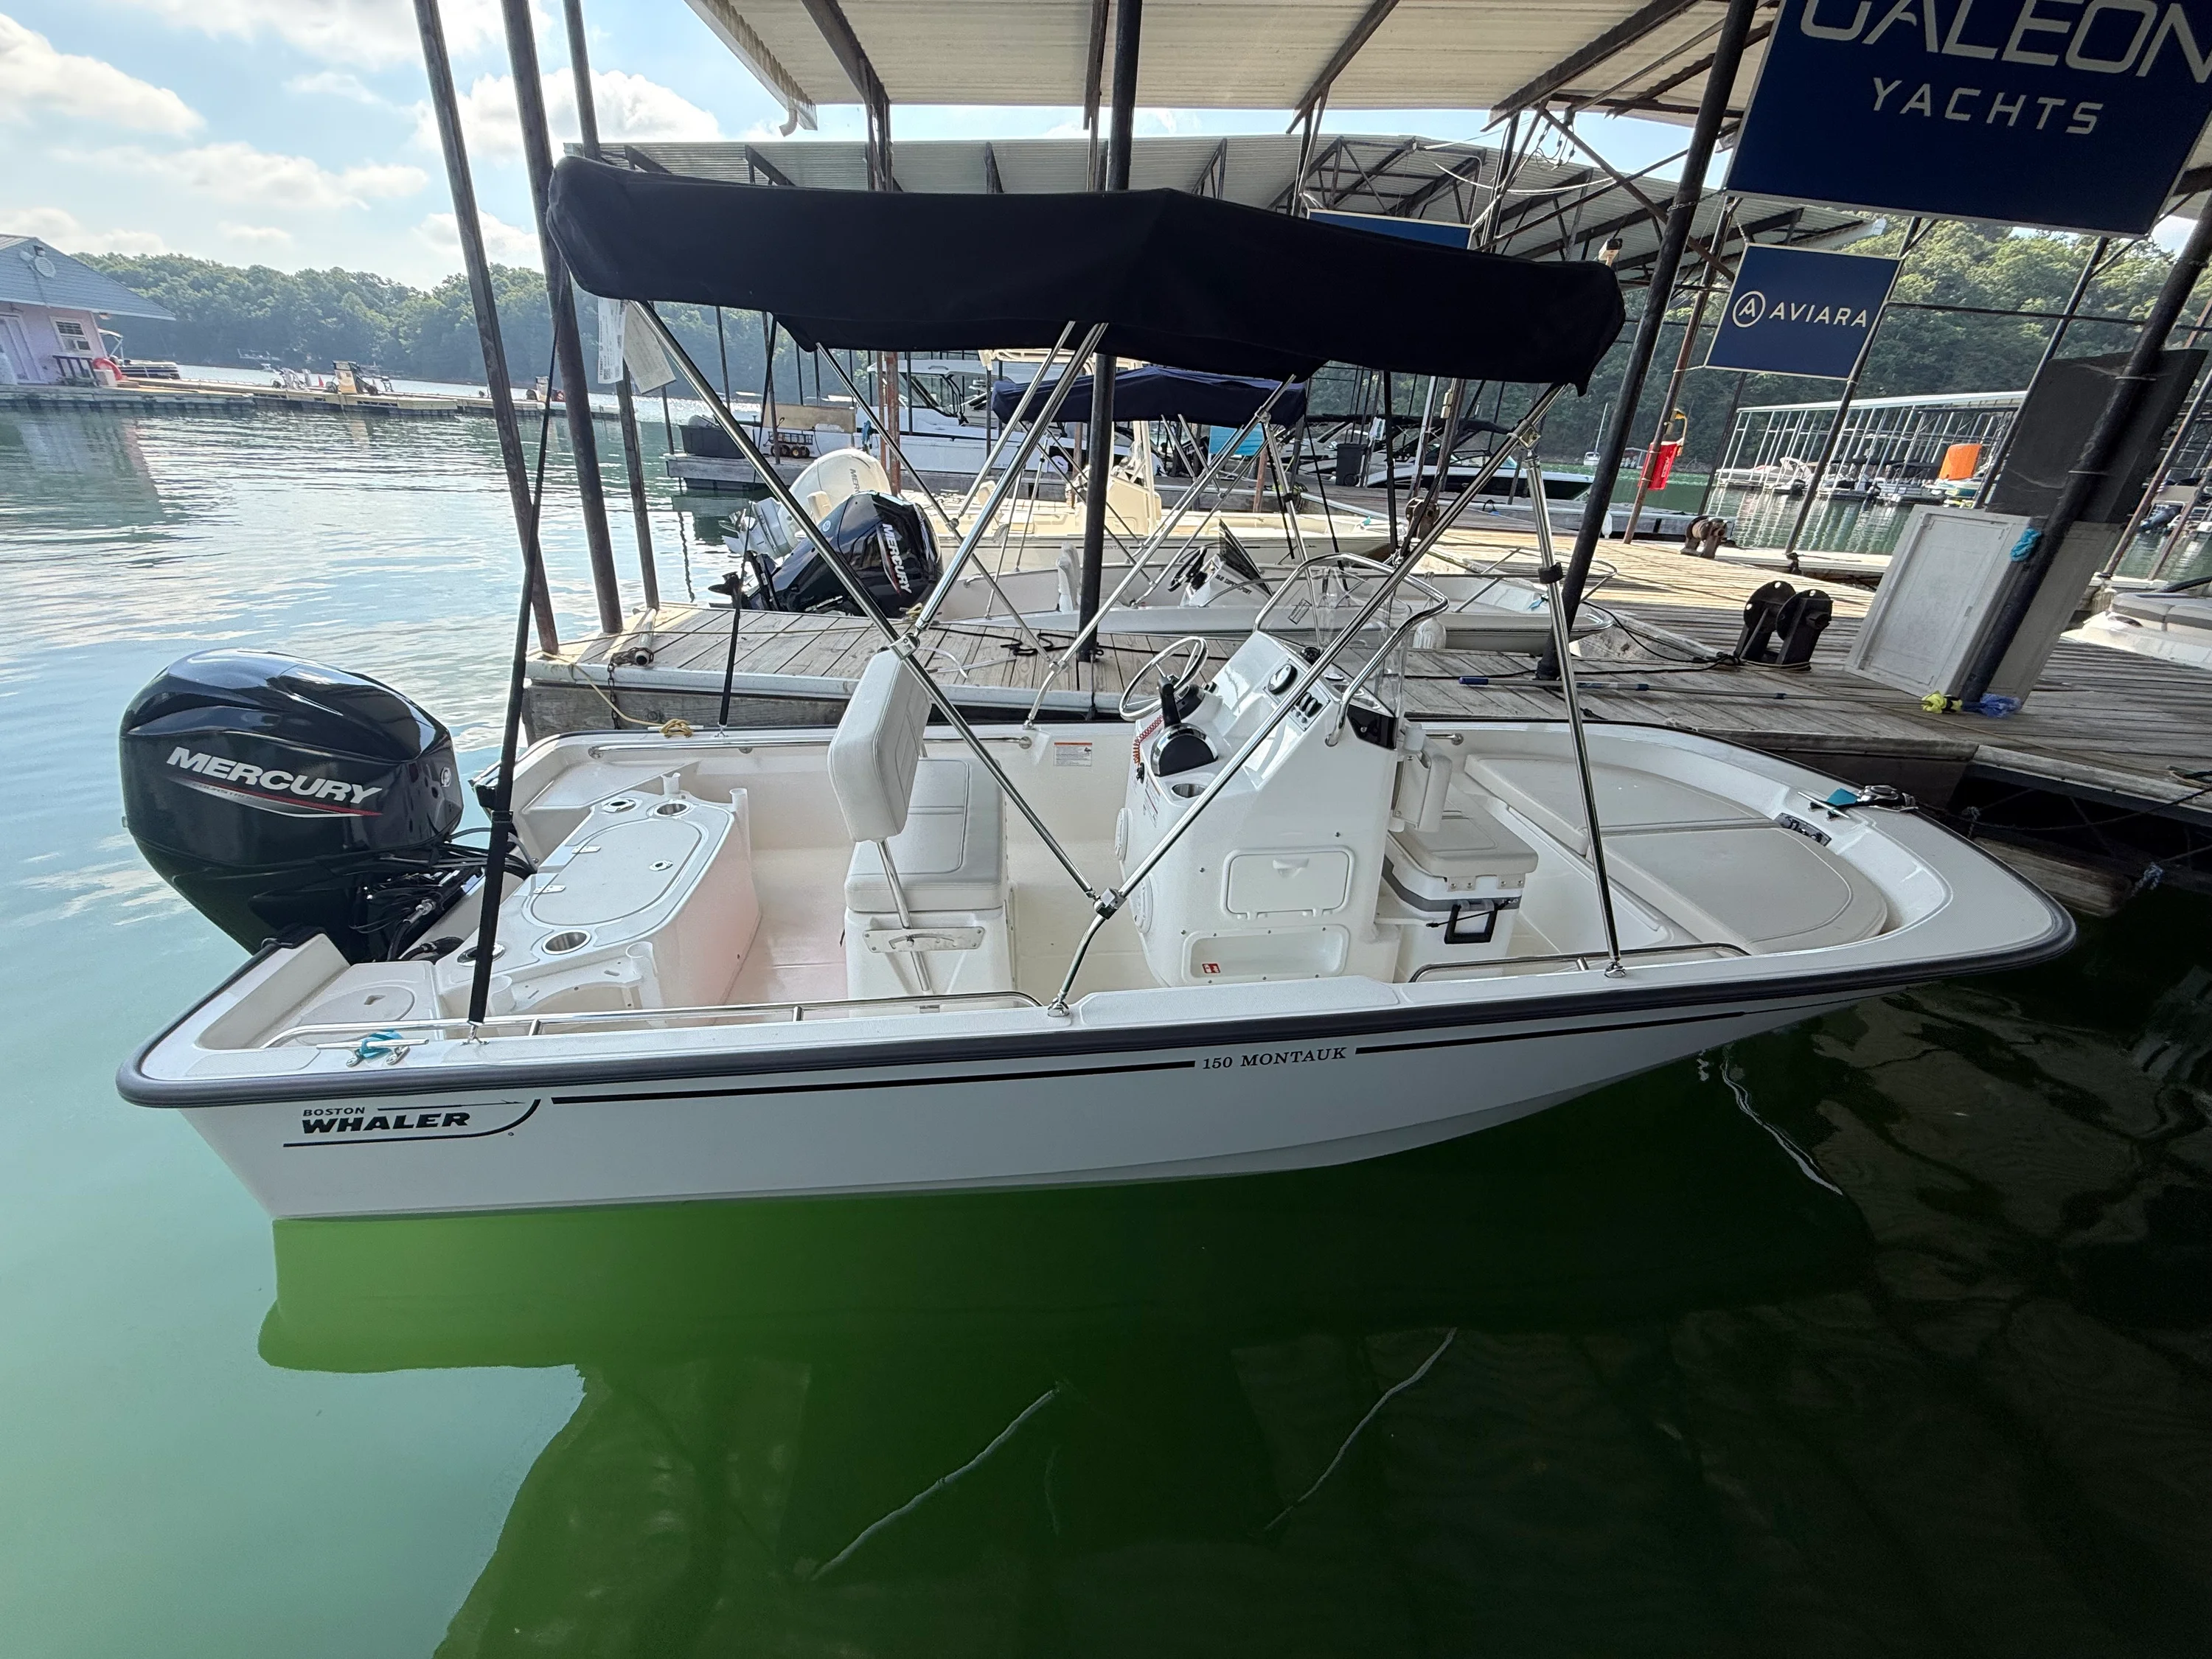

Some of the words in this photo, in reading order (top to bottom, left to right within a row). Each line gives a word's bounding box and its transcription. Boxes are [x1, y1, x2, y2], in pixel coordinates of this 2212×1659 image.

[1873, 77, 2104, 135] YACHTS
[1768, 302, 1867, 327] AVIARA
[882, 523, 913, 594] MERCURY
[167, 746, 383, 804] MERCURY
[1203, 1057, 1233, 1069] 150
[1240, 1047, 1347, 1067] MONTAUK
[302, 1107, 365, 1116] BOSTON
[302, 1112, 470, 1134] WHALER
